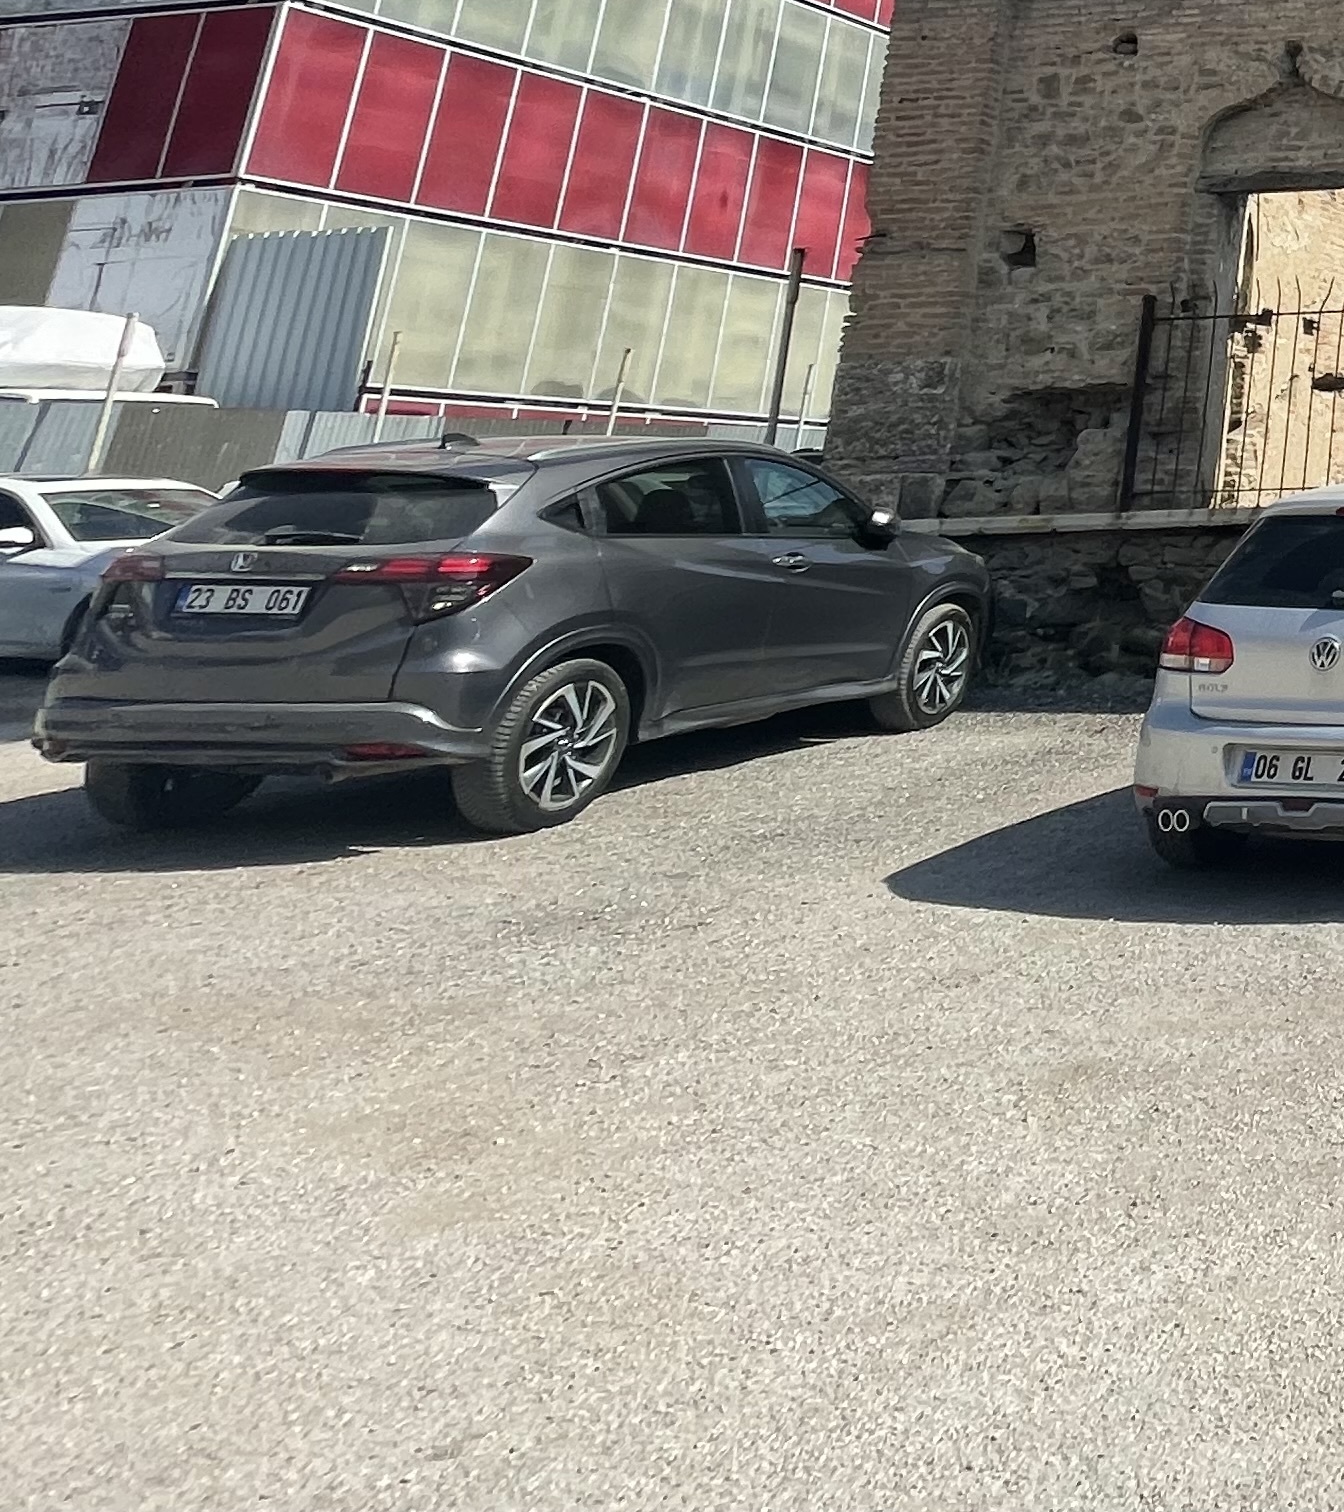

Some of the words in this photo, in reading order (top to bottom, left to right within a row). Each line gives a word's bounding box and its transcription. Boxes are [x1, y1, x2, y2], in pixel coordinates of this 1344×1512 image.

[186, 588, 215, 610] 23
[224, 589, 253, 610] BS
[264, 589, 304, 612] 061
[1254, 754, 1281, 780] 06
[1291, 756, 1315, 782] GL
